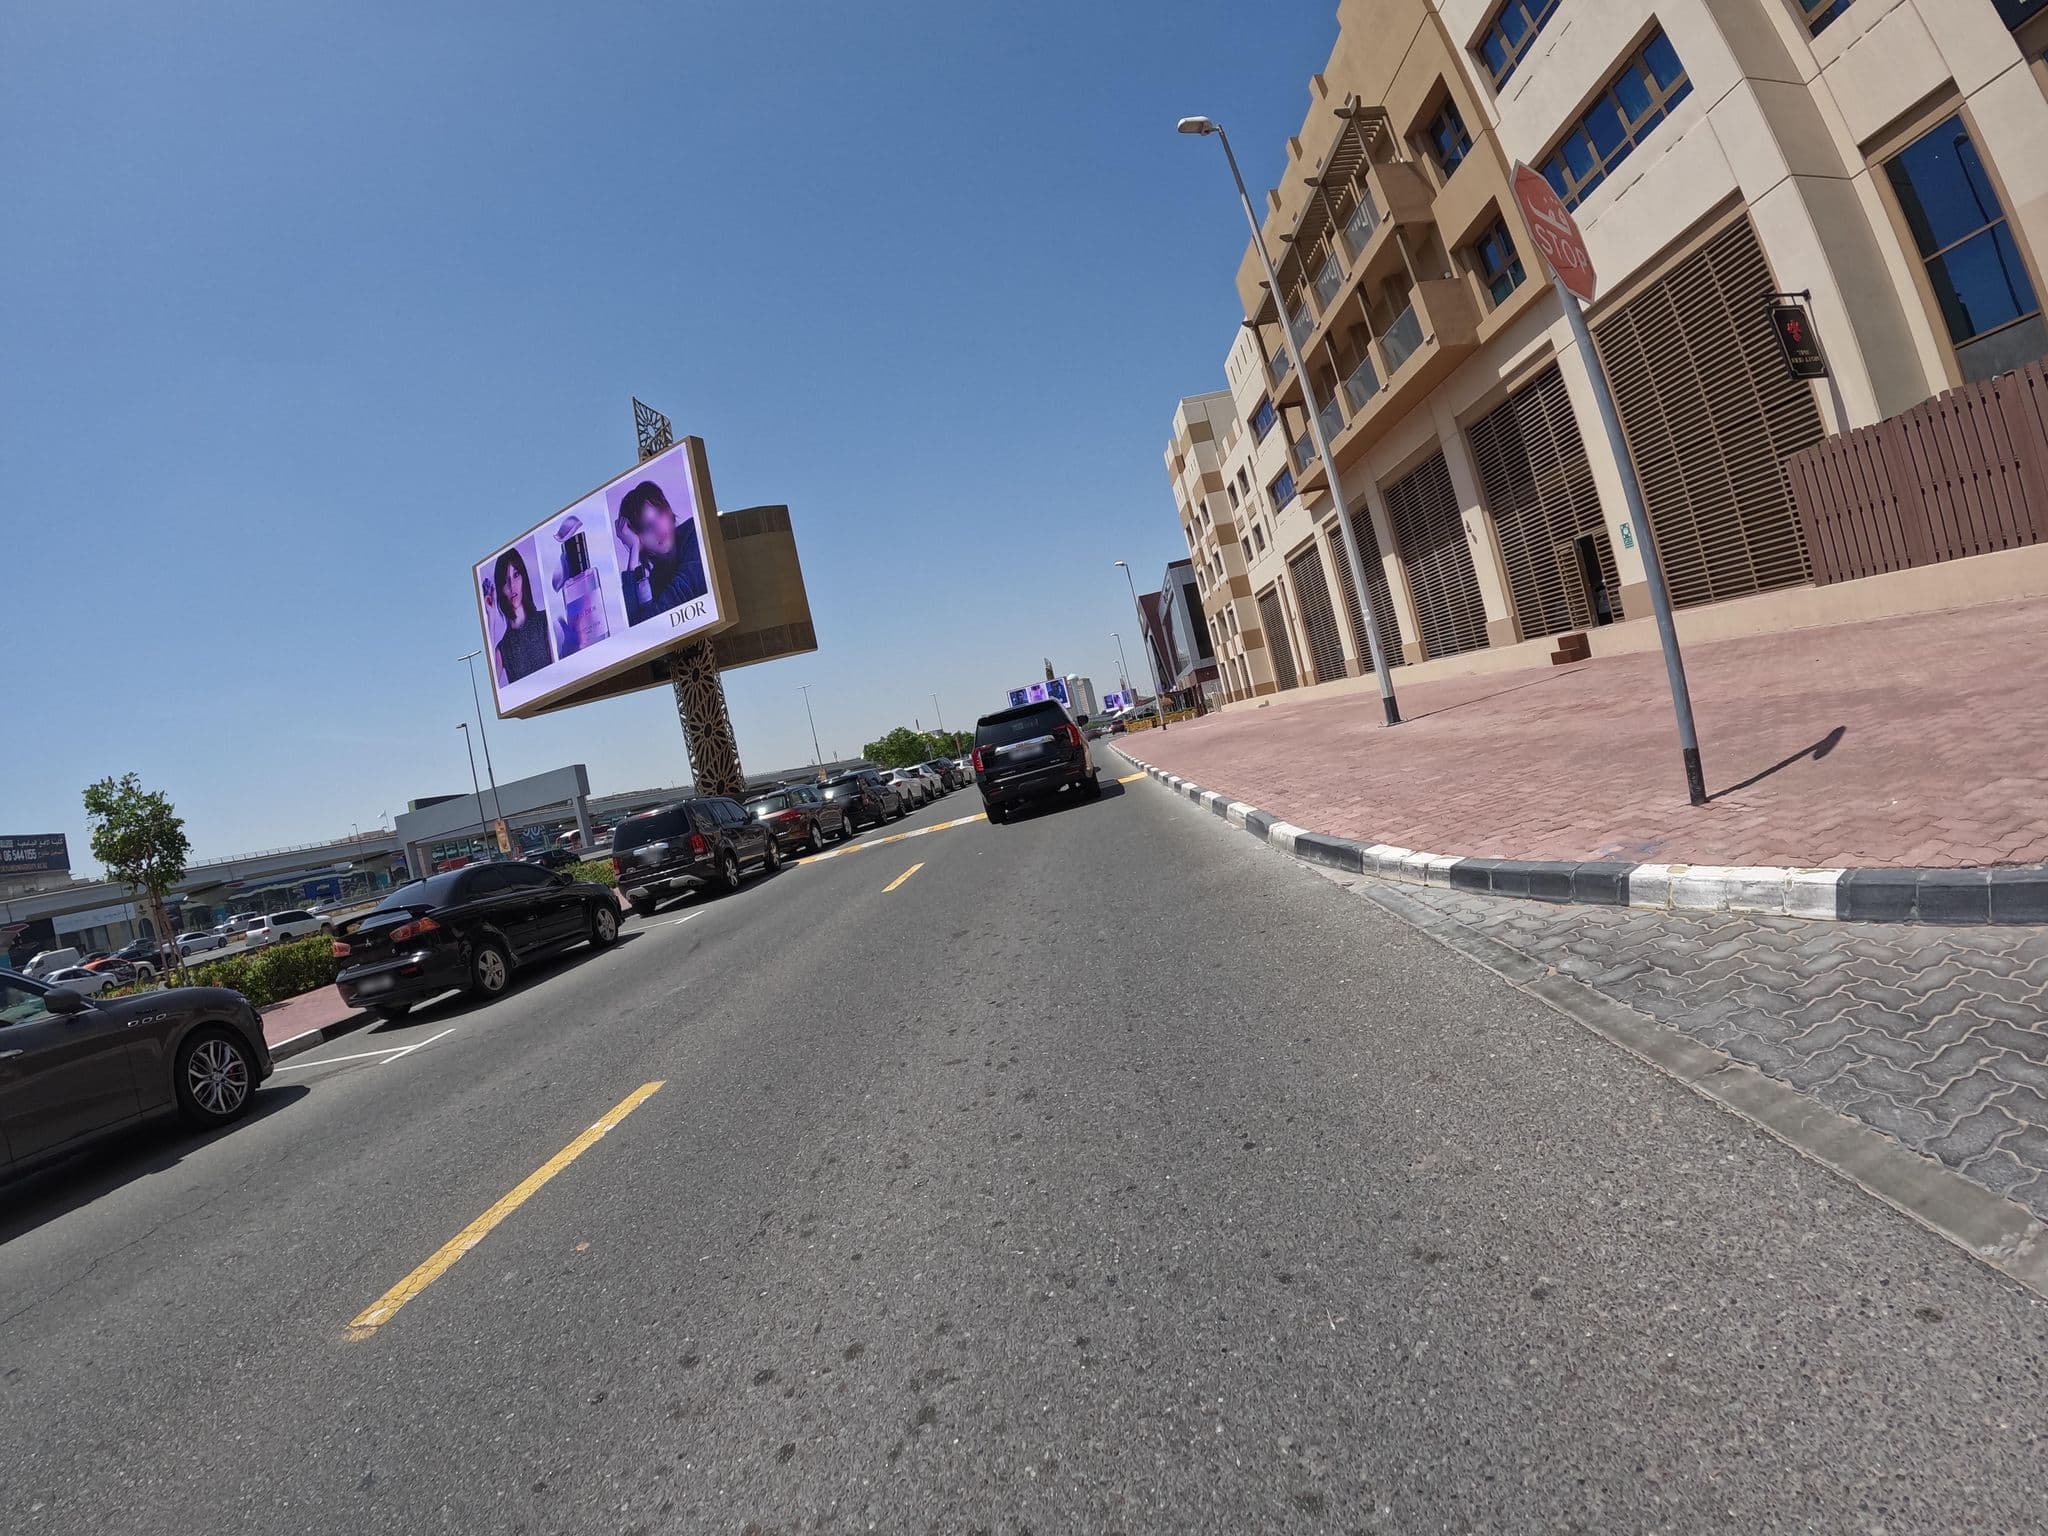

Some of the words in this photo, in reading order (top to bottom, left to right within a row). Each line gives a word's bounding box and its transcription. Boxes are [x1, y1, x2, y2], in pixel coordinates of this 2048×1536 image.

[1528, 195, 1572, 236] قف
[1535, 223, 1587, 274] STOP
[670, 601, 707, 628] DIOR
